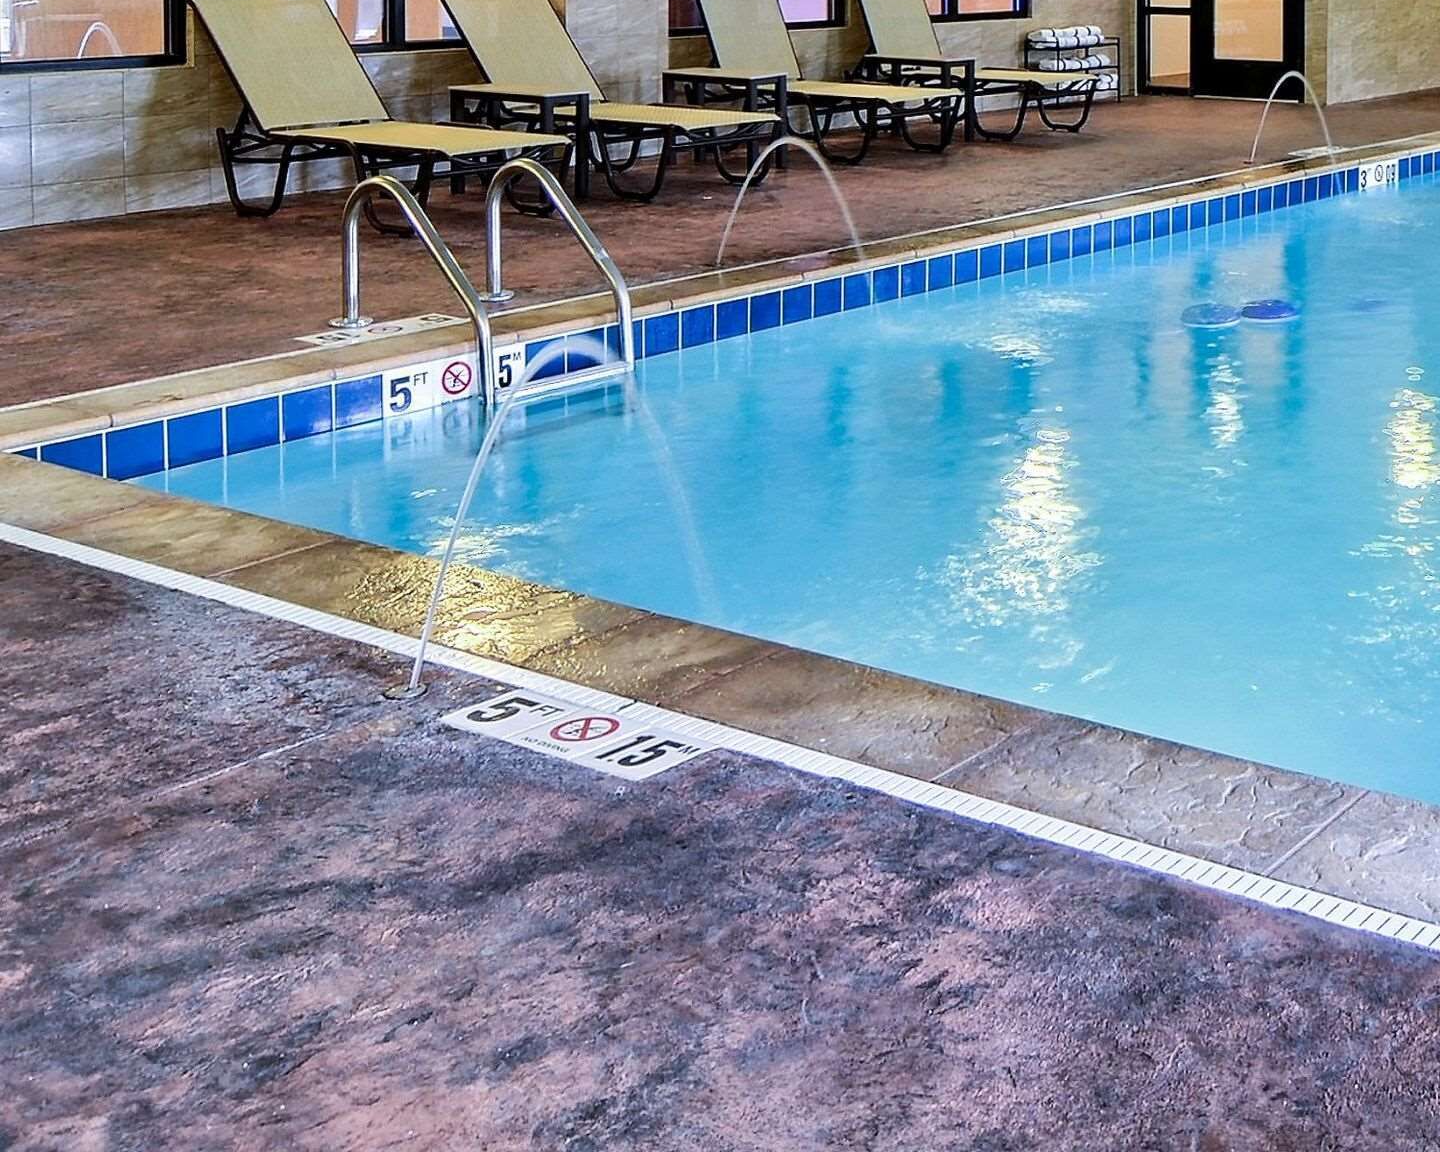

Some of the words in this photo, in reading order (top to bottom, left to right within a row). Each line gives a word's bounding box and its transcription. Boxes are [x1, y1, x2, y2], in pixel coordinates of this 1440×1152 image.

[1360, 169, 1367, 189] 3
[389, 375, 412, 412] 5
[466, 696, 537, 722] 5
